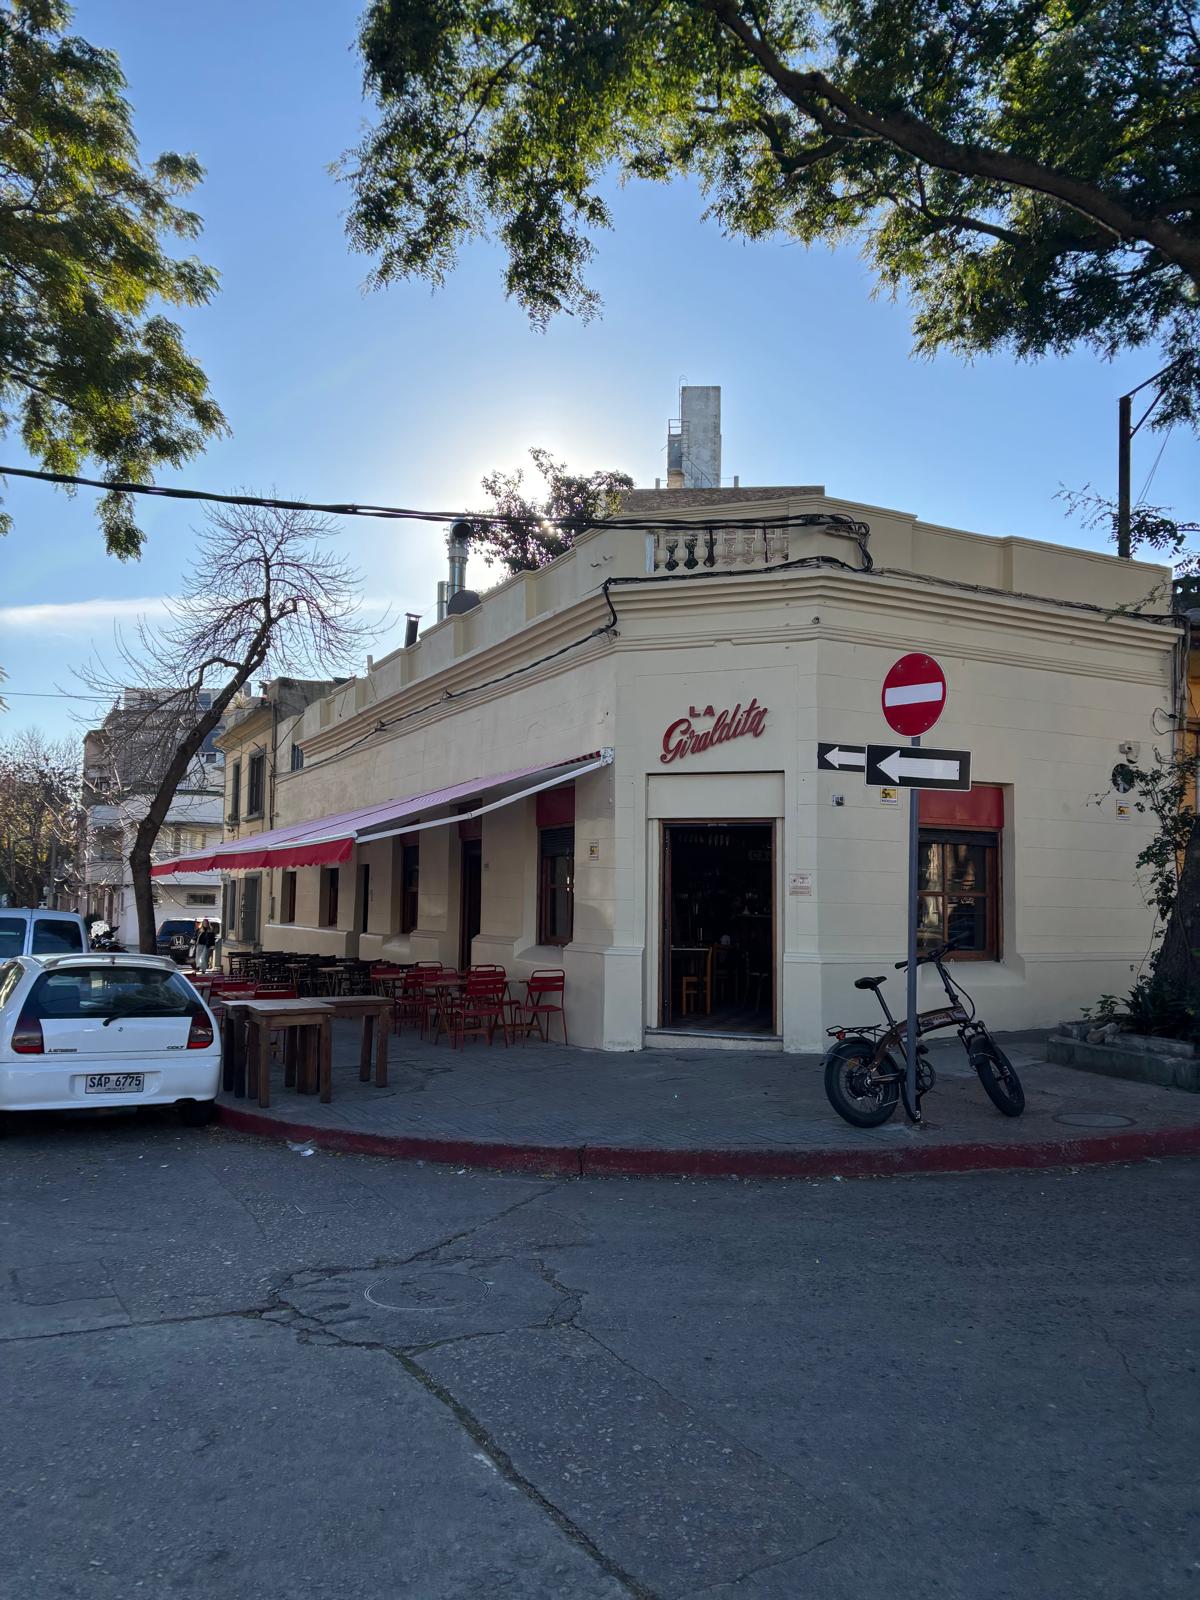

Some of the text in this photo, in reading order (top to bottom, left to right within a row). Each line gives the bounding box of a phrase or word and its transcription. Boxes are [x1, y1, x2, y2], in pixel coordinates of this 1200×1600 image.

[689, 705, 715, 718] LA
[660, 698, 768, 764] Giraldita
[89, 1075, 142, 1088] SAP 6775
